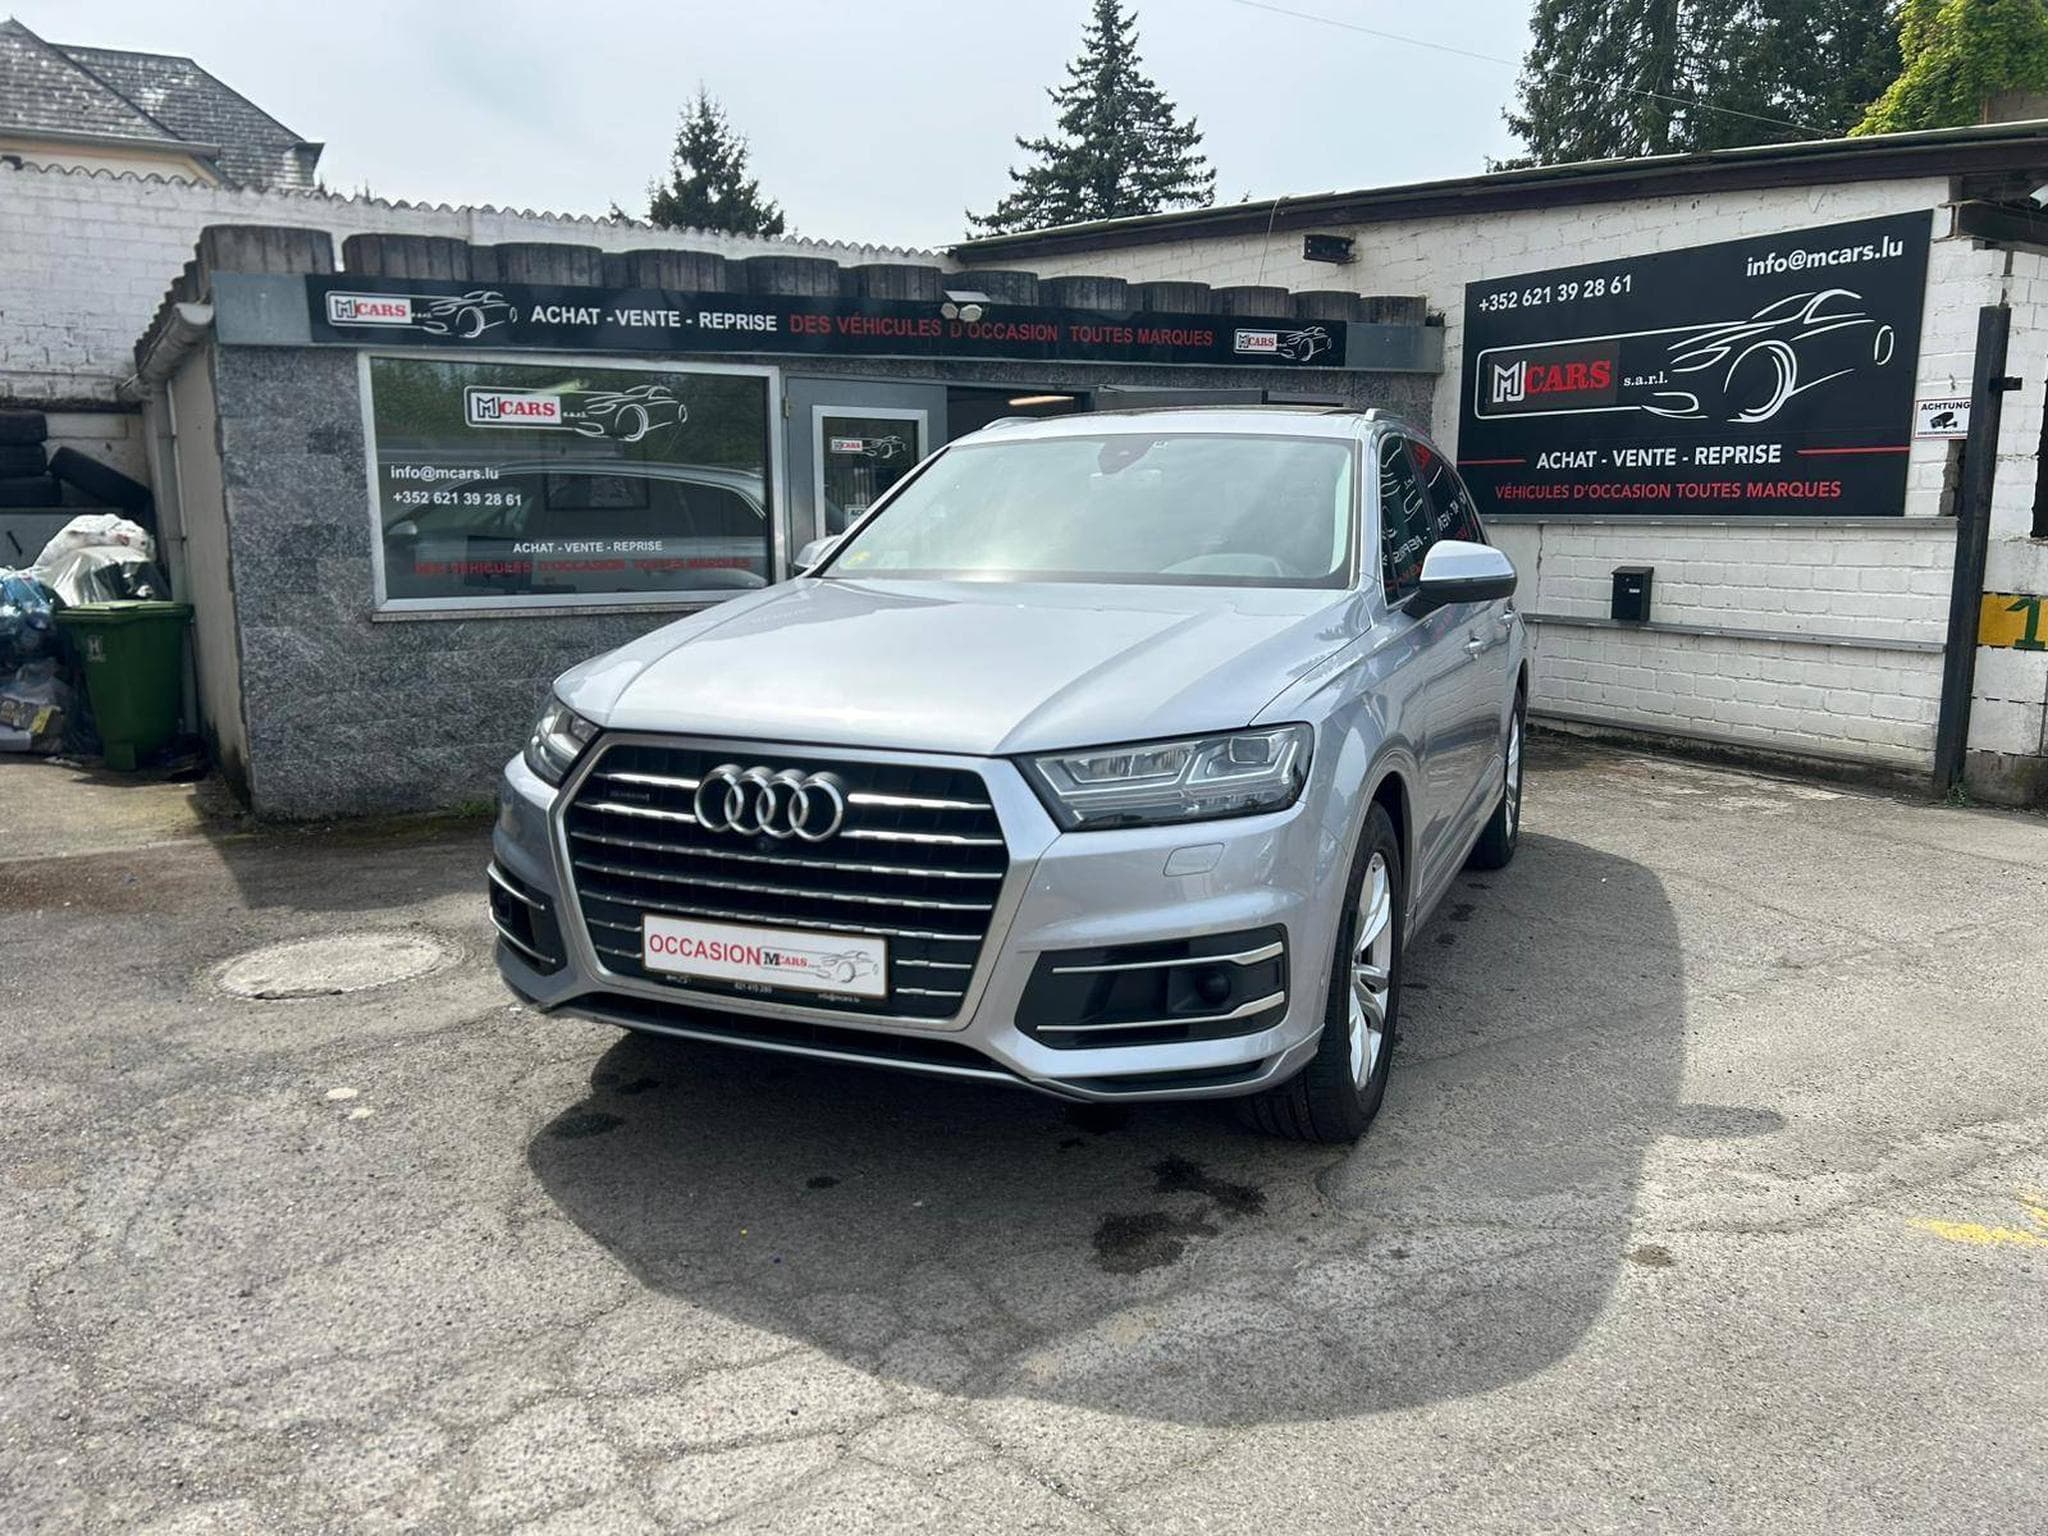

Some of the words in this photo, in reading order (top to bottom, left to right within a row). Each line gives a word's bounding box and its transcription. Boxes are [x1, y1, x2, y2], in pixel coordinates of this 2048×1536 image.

[1746, 235, 1904, 277] info@mcars.lu
[1479, 291, 1518, 312] +352
[1522, 286, 1551, 307] 621
[1557, 282, 1579, 302] 39
[1583, 278, 1605, 298] 28
[1610, 274, 1632, 295] 61
[531, 305, 601, 325] ACHAT
[699, 311, 777, 332] REPRISE
[789, 314, 831, 334] DES
[836, 313, 942, 337] VÉHICULES
[1070, 325, 1133, 343] TOUTES
[1137, 328, 1213, 346] MARQUES
[1623, 371, 1668, 386] s.a.r.l.
[1921, 401, 1971, 411] ACHTUNG
[1536, 450, 1597, 469] ACHAT
[1612, 448, 1677, 467] VENTE
[1694, 444, 1782, 465] REPRISE
[390, 465, 499, 482] info@mcars.lu
[393, 491, 429, 504] +352
[433, 491, 458, 504] 621
[463, 492, 481, 505] 39
[484, 493, 502, 506] 28
[506, 493, 522, 506] 61
[1495, 482, 1570, 499] VÉHICULES
[1573, 482, 1671, 499] D'OCCASION
[1676, 482, 1741, 498] TOUTES
[1746, 481, 1842, 499] MARQUES
[512, 542, 554, 553] ACHAT
[564, 542, 604, 553] VENTE
[613, 540, 663, 552] REPRISE
[2004, 596, 2046, 650] 1
[650, 933, 762, 966] OCCASION
